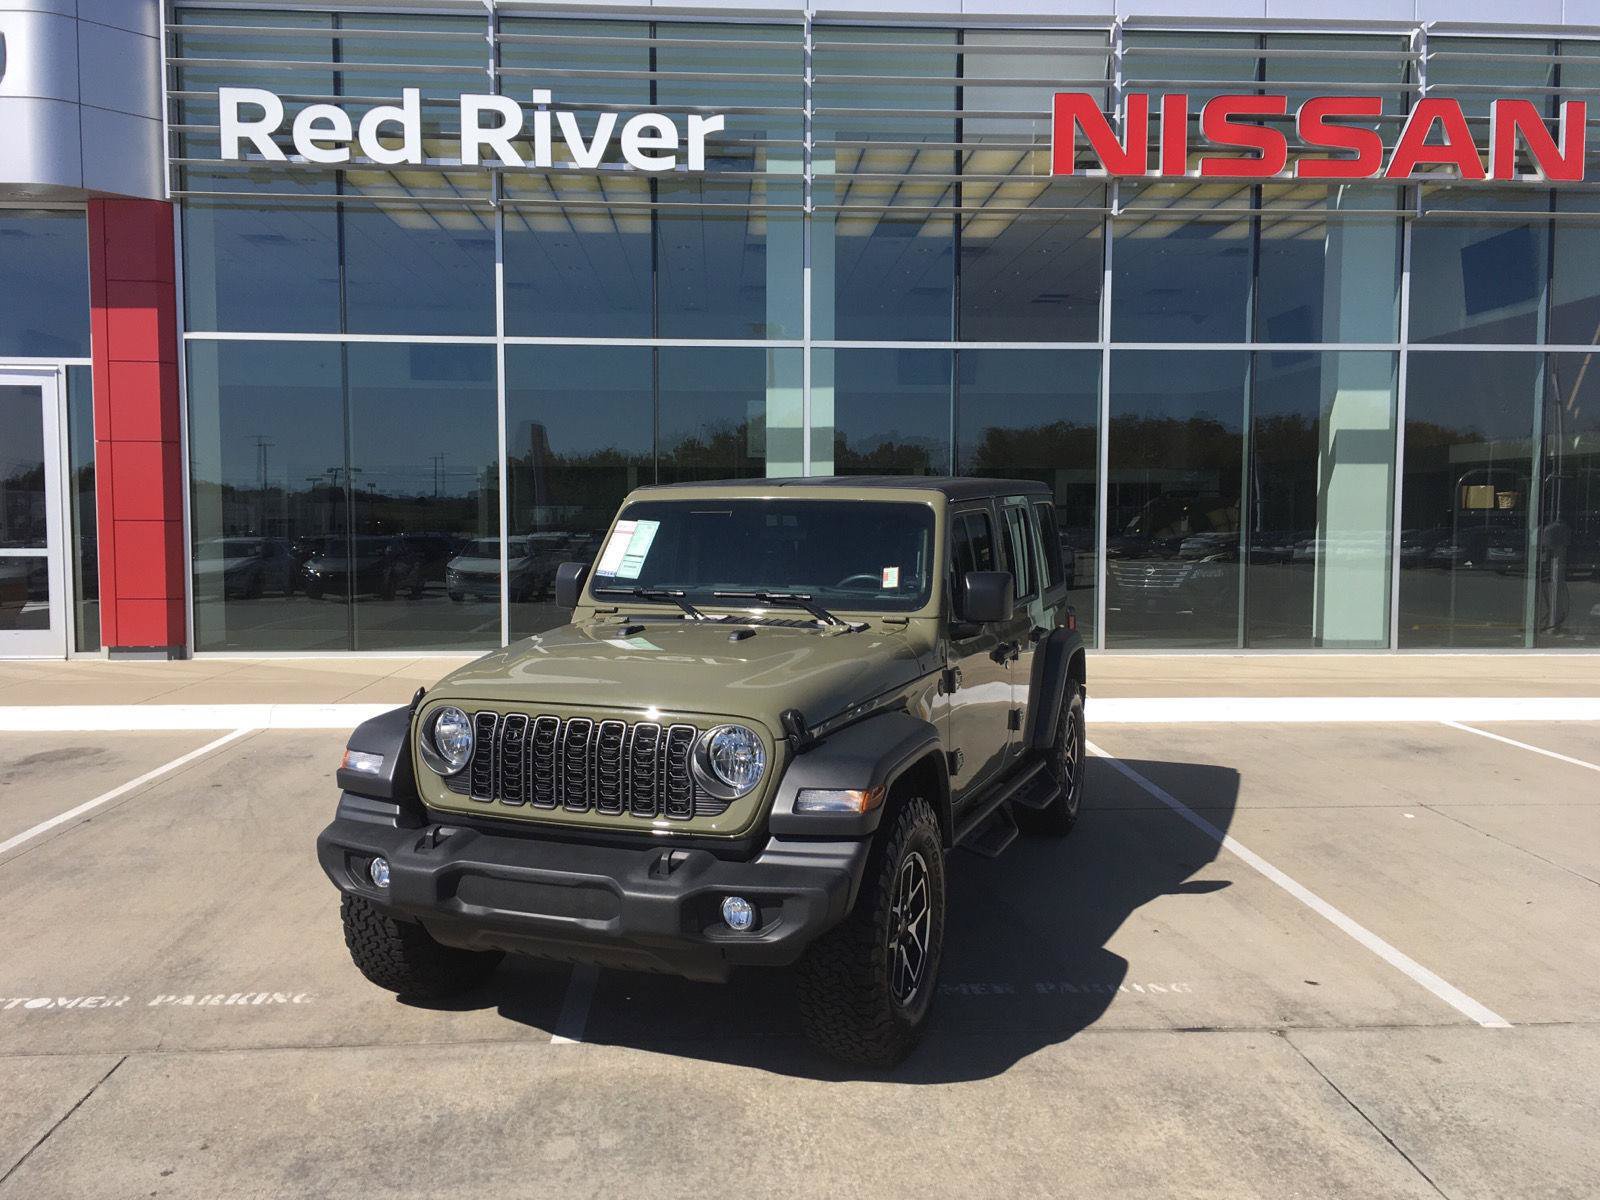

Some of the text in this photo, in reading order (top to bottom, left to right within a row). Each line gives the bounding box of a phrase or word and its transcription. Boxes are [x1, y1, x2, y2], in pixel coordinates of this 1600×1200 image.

[218, 87, 725, 171] Red River
[1051, 92, 1587, 182] NISSAN
[148, 992, 316, 1006] PARKING
